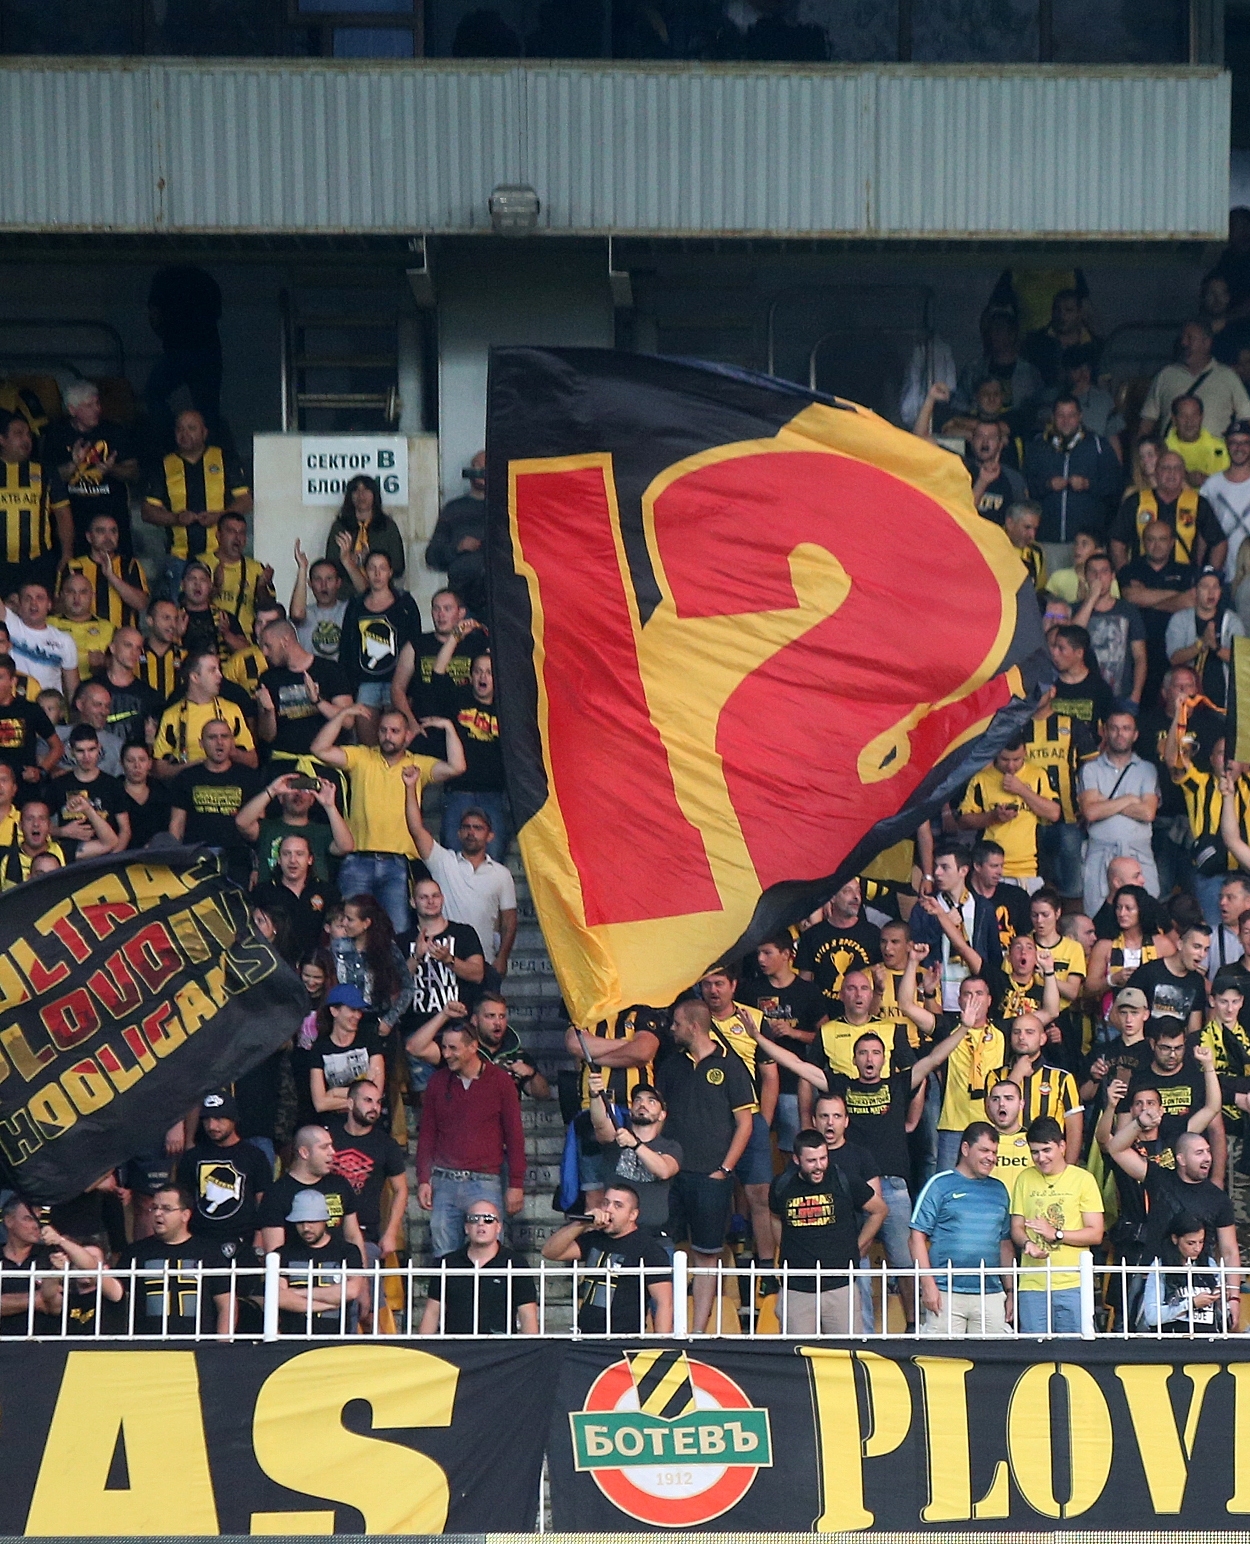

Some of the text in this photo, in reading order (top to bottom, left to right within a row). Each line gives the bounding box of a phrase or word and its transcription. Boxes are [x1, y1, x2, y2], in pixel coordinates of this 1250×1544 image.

[306, 449, 395, 469] СЕКТОР В
[511, 960, 536, 971] РЕД
[0, 889, 254, 1084] LOVDIV
[413, 985, 460, 1014] RAW
[0, 943, 278, 1166] HOOLIGANS
[995, 1155, 1028, 1168] fbet
[24, 1344, 462, 1536] AS
[583, 1421, 760, 1457] БОТЕВЪ
[656, 1472, 694, 1486] 1912
